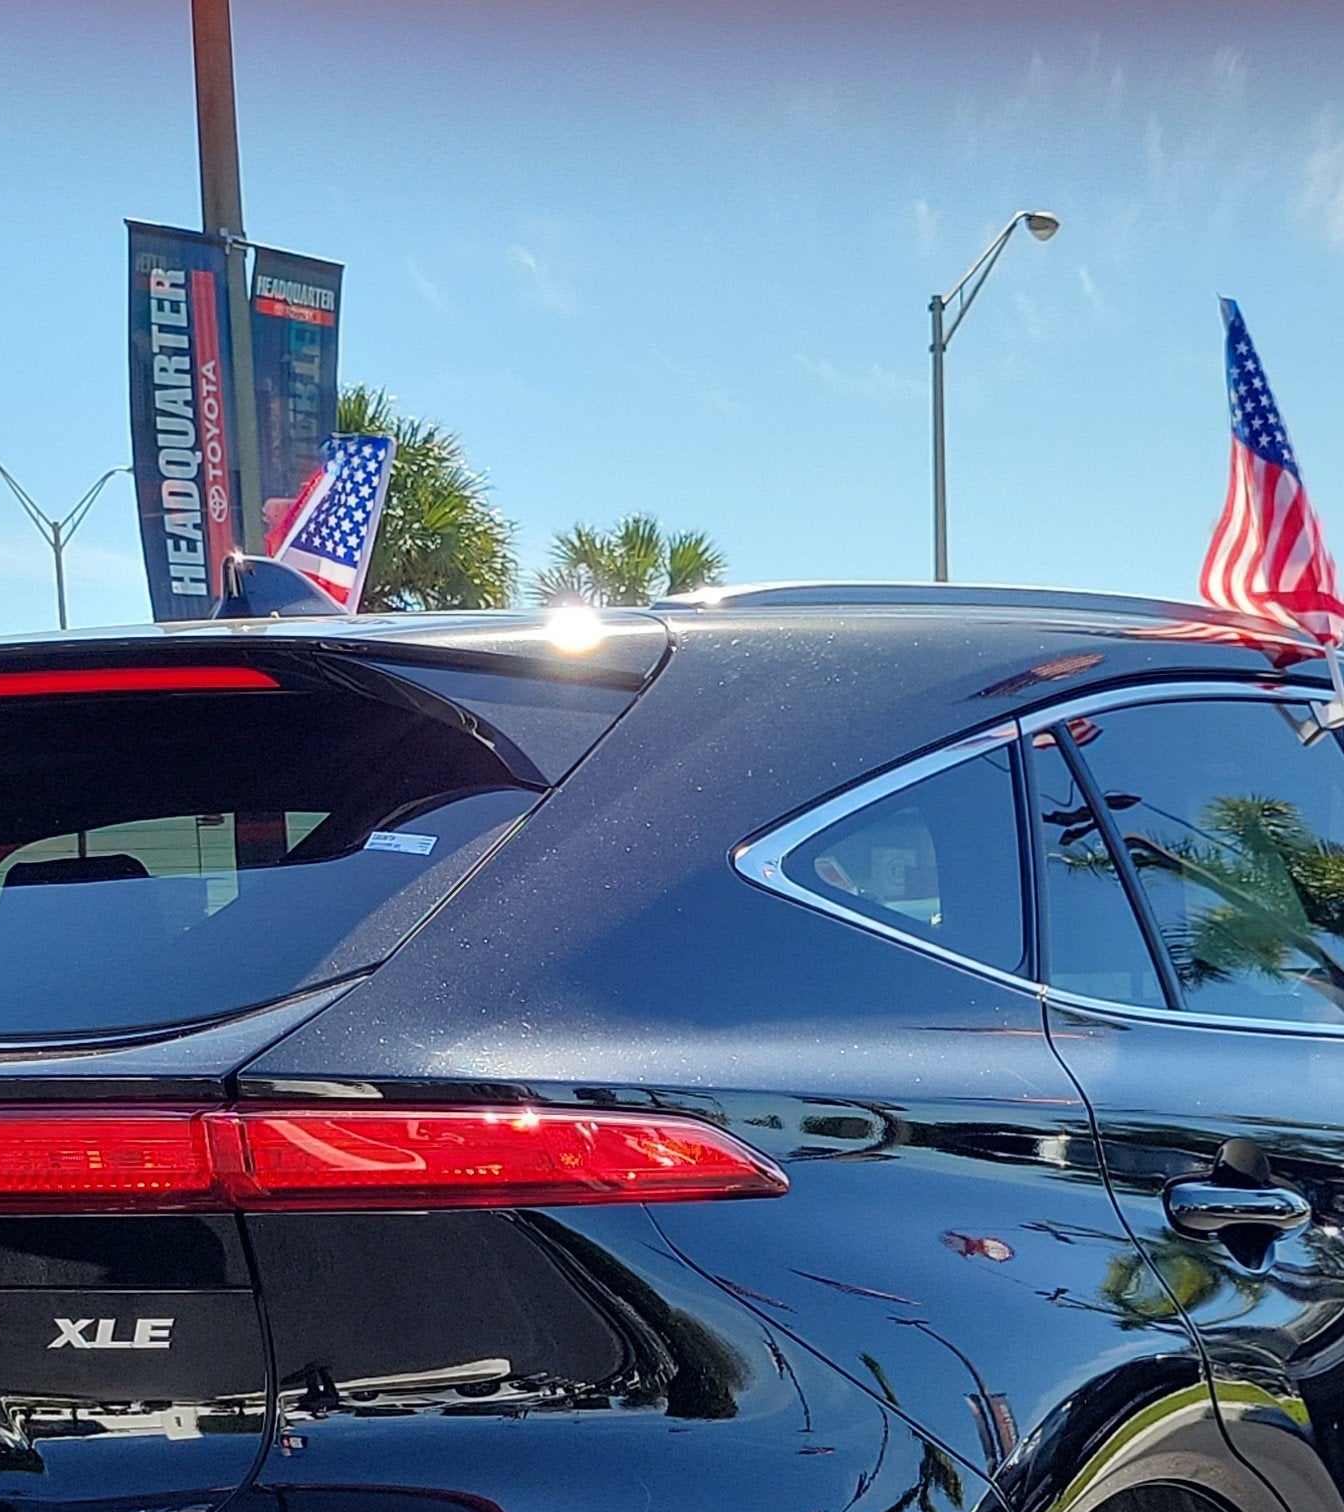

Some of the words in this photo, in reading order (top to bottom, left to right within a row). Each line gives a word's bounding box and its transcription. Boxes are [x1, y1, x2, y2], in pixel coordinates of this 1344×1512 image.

[256, 275, 335, 311] HEADQUARTER
[149, 267, 209, 595] HEADQUARTER
[200, 360, 227, 480] TOYOTA
[47, 1318, 175, 1349] XLE
